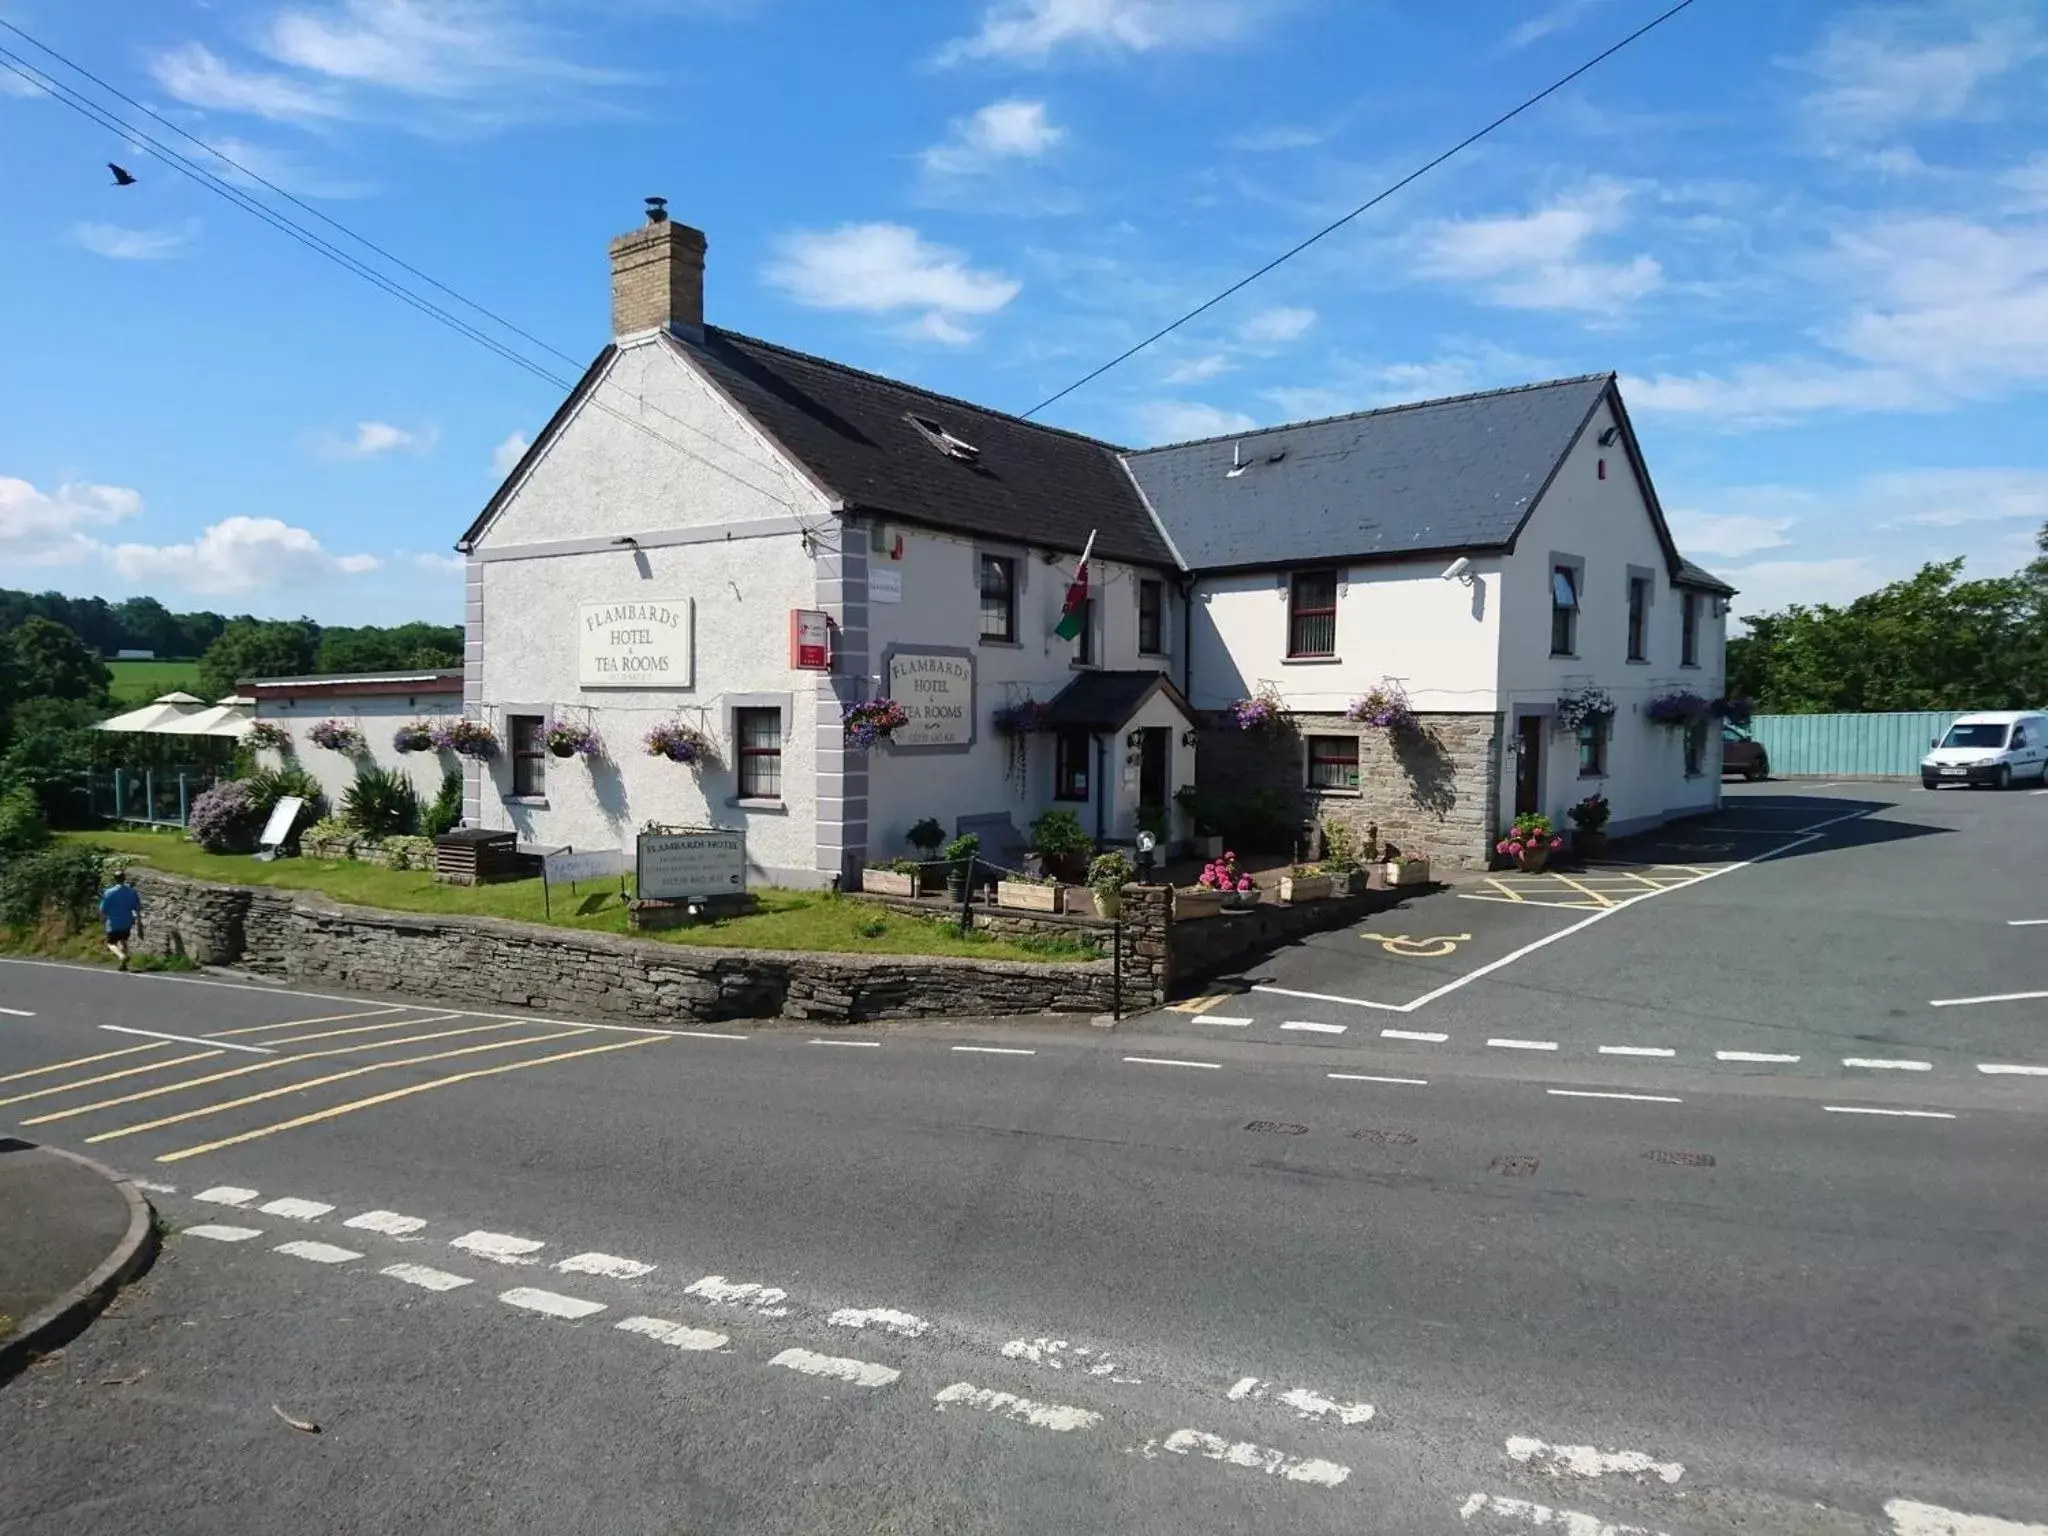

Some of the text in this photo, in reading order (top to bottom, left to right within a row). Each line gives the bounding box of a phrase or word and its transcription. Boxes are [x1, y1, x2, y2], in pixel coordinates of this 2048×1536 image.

[586, 605, 680, 632] FLAMBARDS
[610, 629, 653, 645] HOTEL
[595, 655, 669, 672] TEA ROOMS
[892, 658, 970, 682] FLAMBARDS
[914, 679, 949, 693] HOTEL
[901, 705, 963, 719] TEA ROOMS
[646, 839, 738, 854] FLAMBARDS HOTEL
